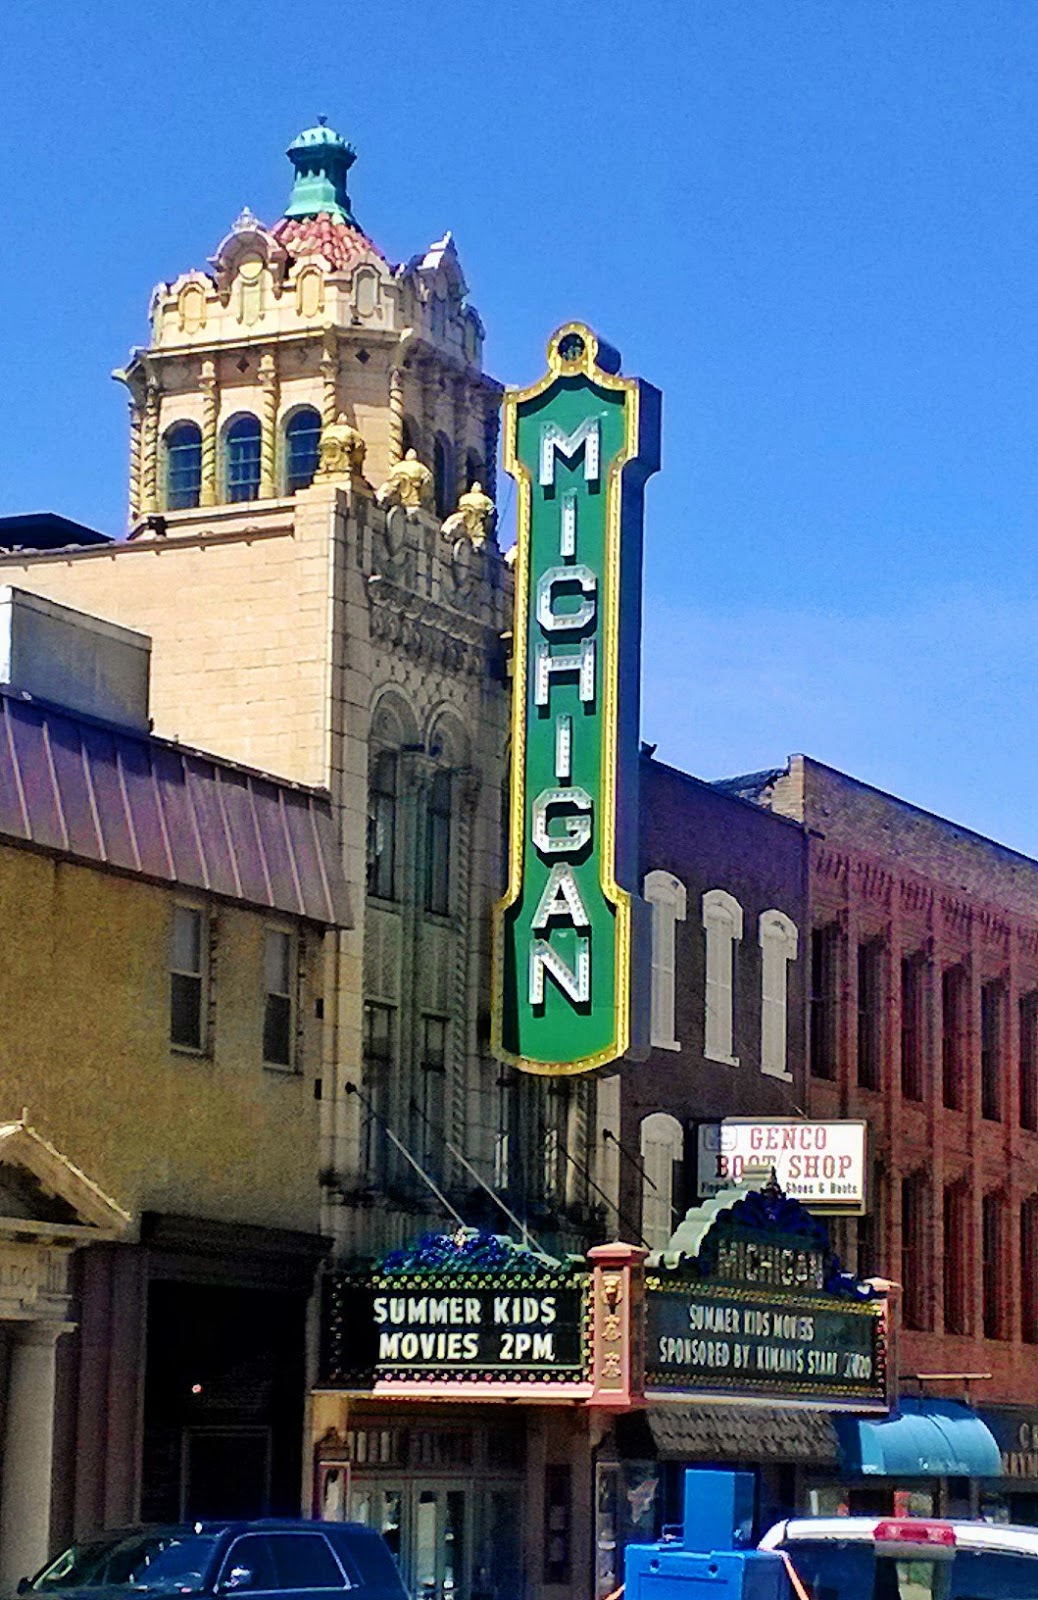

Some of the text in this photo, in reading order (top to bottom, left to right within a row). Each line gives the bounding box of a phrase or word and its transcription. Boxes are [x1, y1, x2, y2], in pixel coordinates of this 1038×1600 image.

[529, 417, 601, 1005] MICHIGAN
[750, 1126, 827, 1150] GENCO
[715, 1154, 853, 1179] BOOT SHOP
[372, 1296, 557, 1325] SUMMER KIDS
[689, 1303, 740, 1333] SUMMER
[744, 1309, 770, 1337] KIDS
[379, 1332, 480, 1360] MOVIES
[659, 1335, 730, 1367] SPONSORED
[733, 1343, 750, 1369] BY
